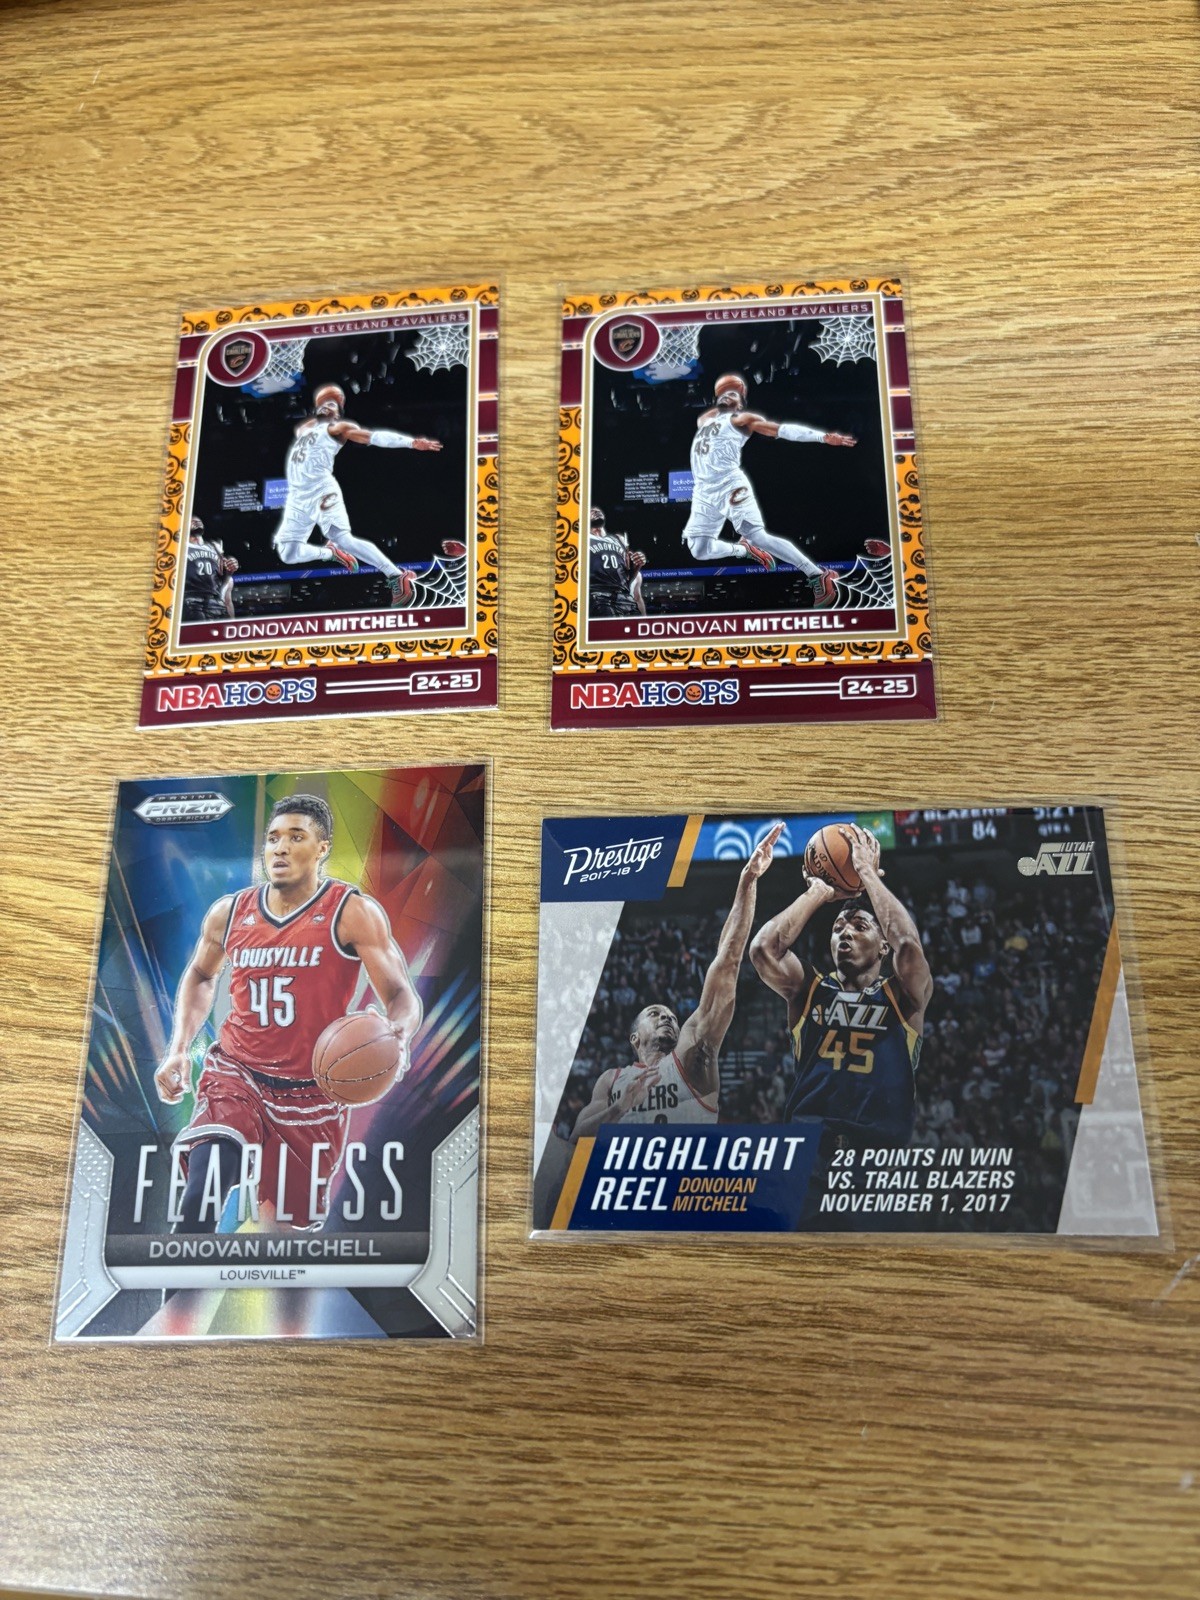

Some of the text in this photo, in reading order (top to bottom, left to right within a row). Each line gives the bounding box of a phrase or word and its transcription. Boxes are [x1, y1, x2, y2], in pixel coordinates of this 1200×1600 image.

[706, 304, 869, 321] CLEVELAND CAVALIERS
[312, 312, 467, 334] CLEVELAND CAVALIERS
[197, 561, 213, 576] 20
[601, 554, 619, 569] 20
[224, 613, 419, 639] DONOVAN MITCHELL
[637, 614, 845, 637] DONOVAN MITCHELL
[416, 674, 474, 690] 24-25
[847, 679, 909, 695] 24-25
[145, 802, 224, 815] PRIZM
[972, 820, 997, 840] 84
[1065, 841, 1095, 852] UTAH
[563, 836, 665, 885] Prestige
[579, 867, 631, 882] 2017-18
[232, 946, 323, 968] LOUISVILLE
[249, 976, 297, 1027] 45
[818, 1029, 876, 1074] 45
[603, 1136, 806, 1171] HIGHLIGHT
[831, 1147, 1014, 1167] 28 POINTS IN WIN
[133, 1141, 405, 1223] FEARLESS
[678, 1177, 758, 1194] DONOVAN
[827, 1170, 1016, 1189] VS. TRAIL BLAZERS
[590, 1176, 668, 1211] REEL
[672, 1195, 748, 1212] MITCHELL
[819, 1193, 1011, 1214] NOVEMBER 1, 2017
[149, 1239, 382, 1259] DONOVAN MITCHELL
